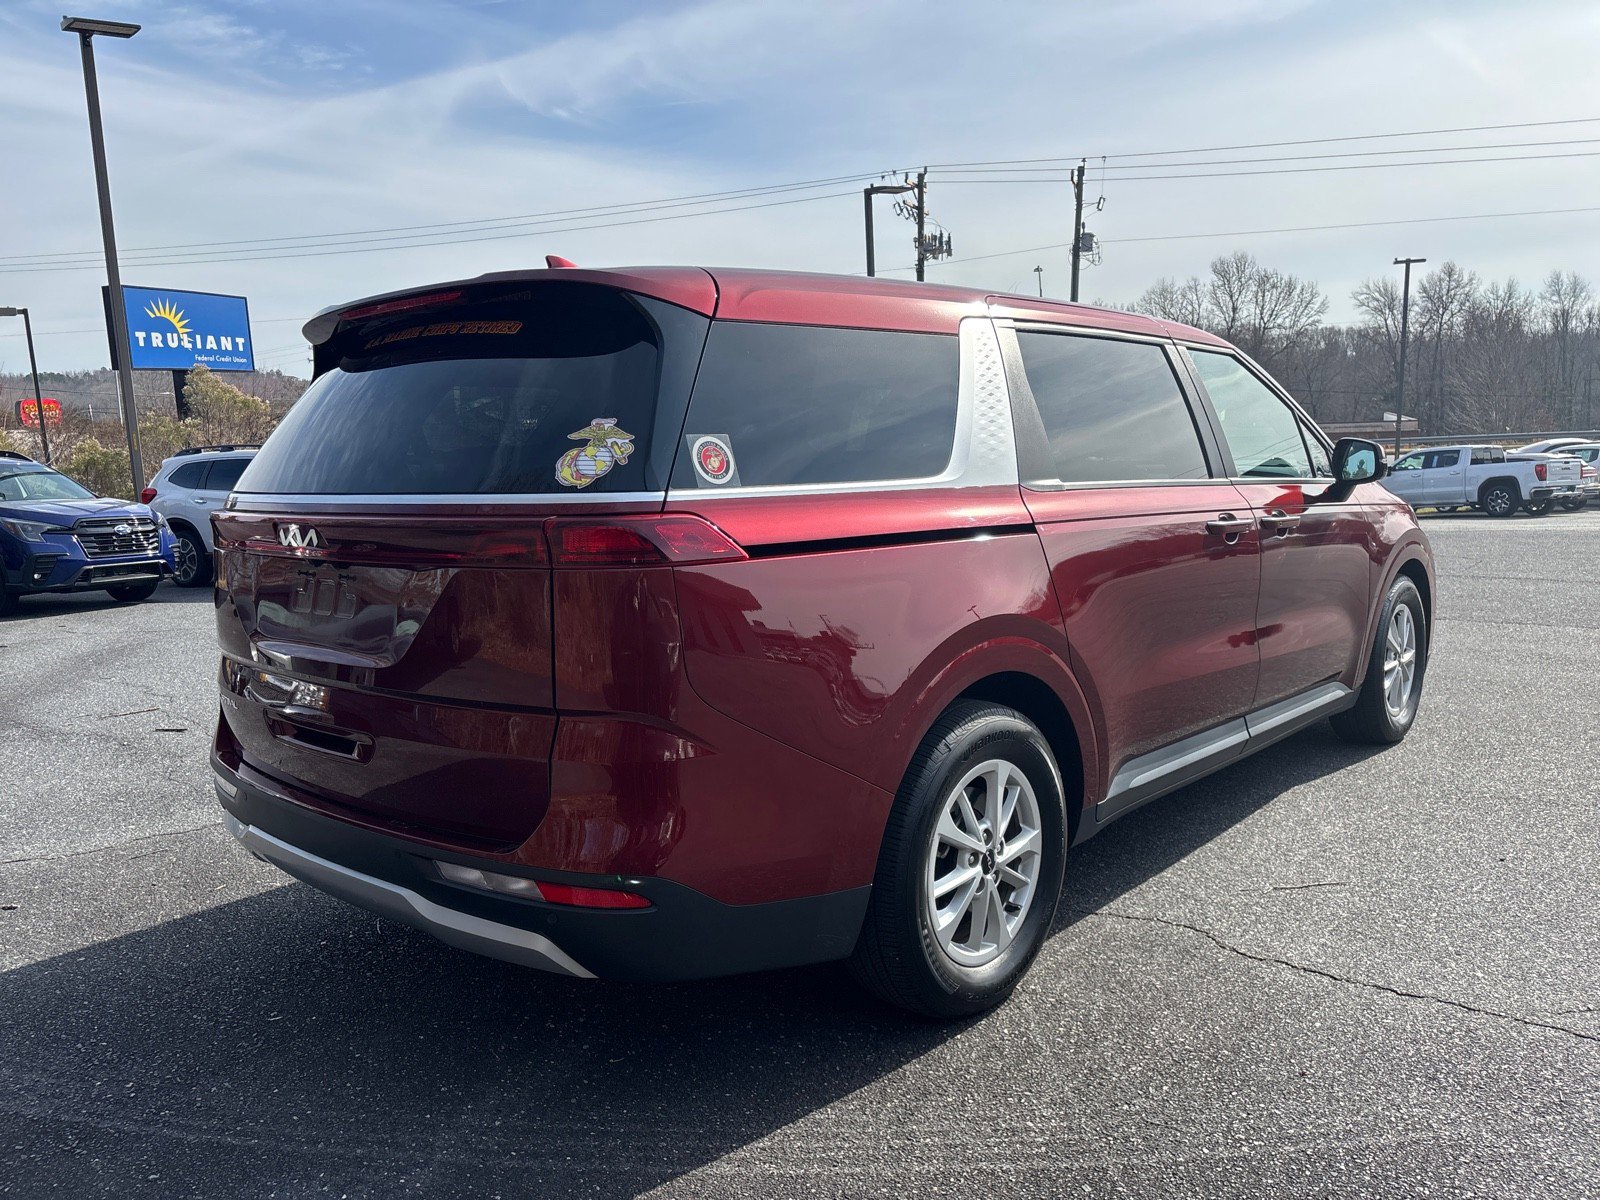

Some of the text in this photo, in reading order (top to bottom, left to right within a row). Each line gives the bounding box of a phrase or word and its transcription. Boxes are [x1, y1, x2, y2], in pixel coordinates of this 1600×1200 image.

[422, 323, 461, 336] CORPS
[460, 321, 523, 334] RETIRED
[134, 331, 245, 352] TRULIANT
[194, 354, 248, 363] Federal Credit Union
[279, 525, 318, 547] KIA
